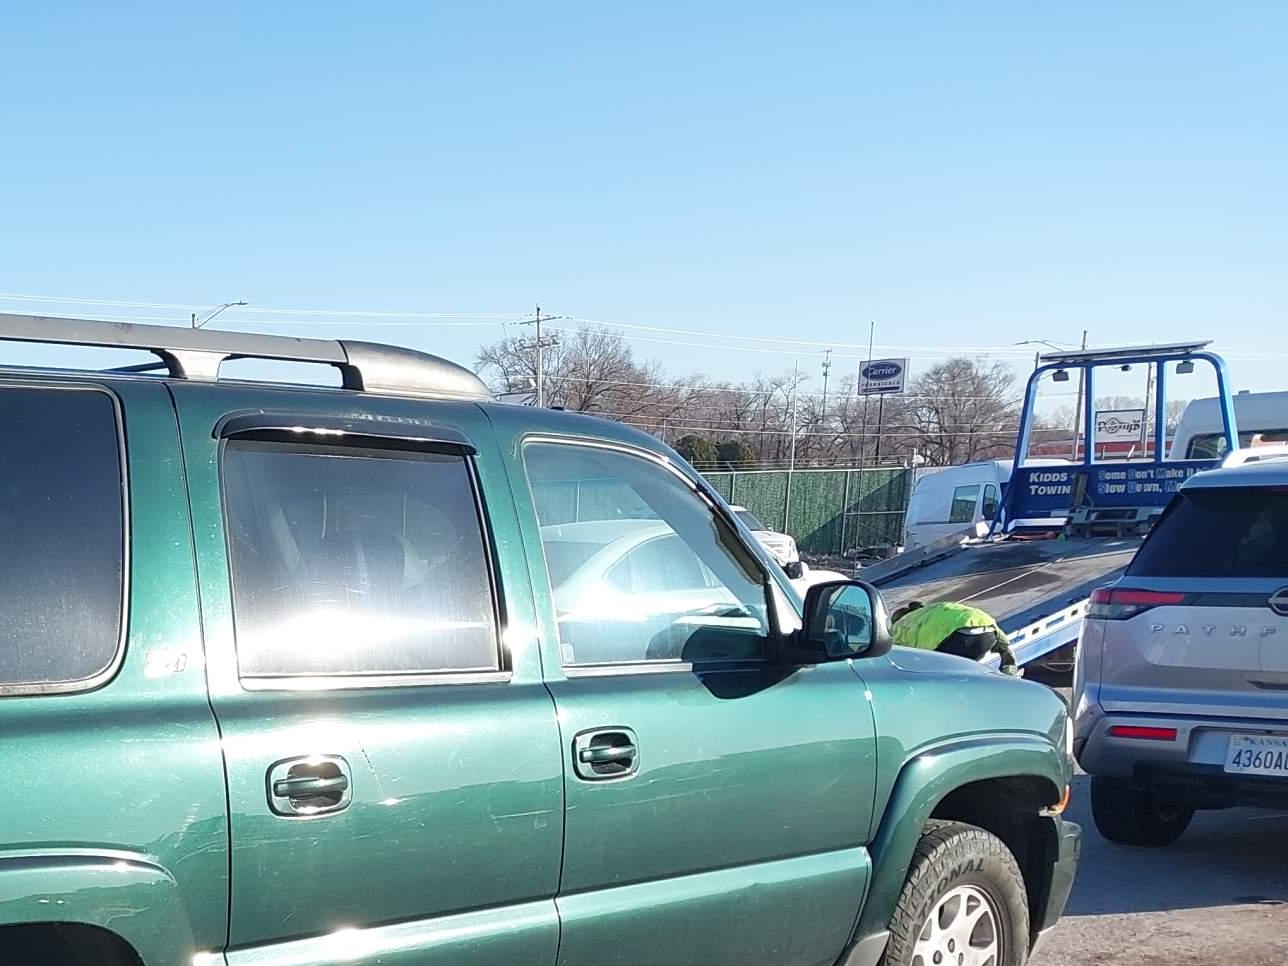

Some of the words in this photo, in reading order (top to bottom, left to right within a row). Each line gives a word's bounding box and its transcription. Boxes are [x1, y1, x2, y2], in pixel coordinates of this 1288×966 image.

[868, 366, 897, 376] Carrier
[1029, 472, 1068, 483] KIDDS
[1098, 470, 1126, 480] Some
[1128, 468, 1154, 479] Don't
[1156, 467, 1184, 478] Make
[1097, 482, 1126, 494] Slow
